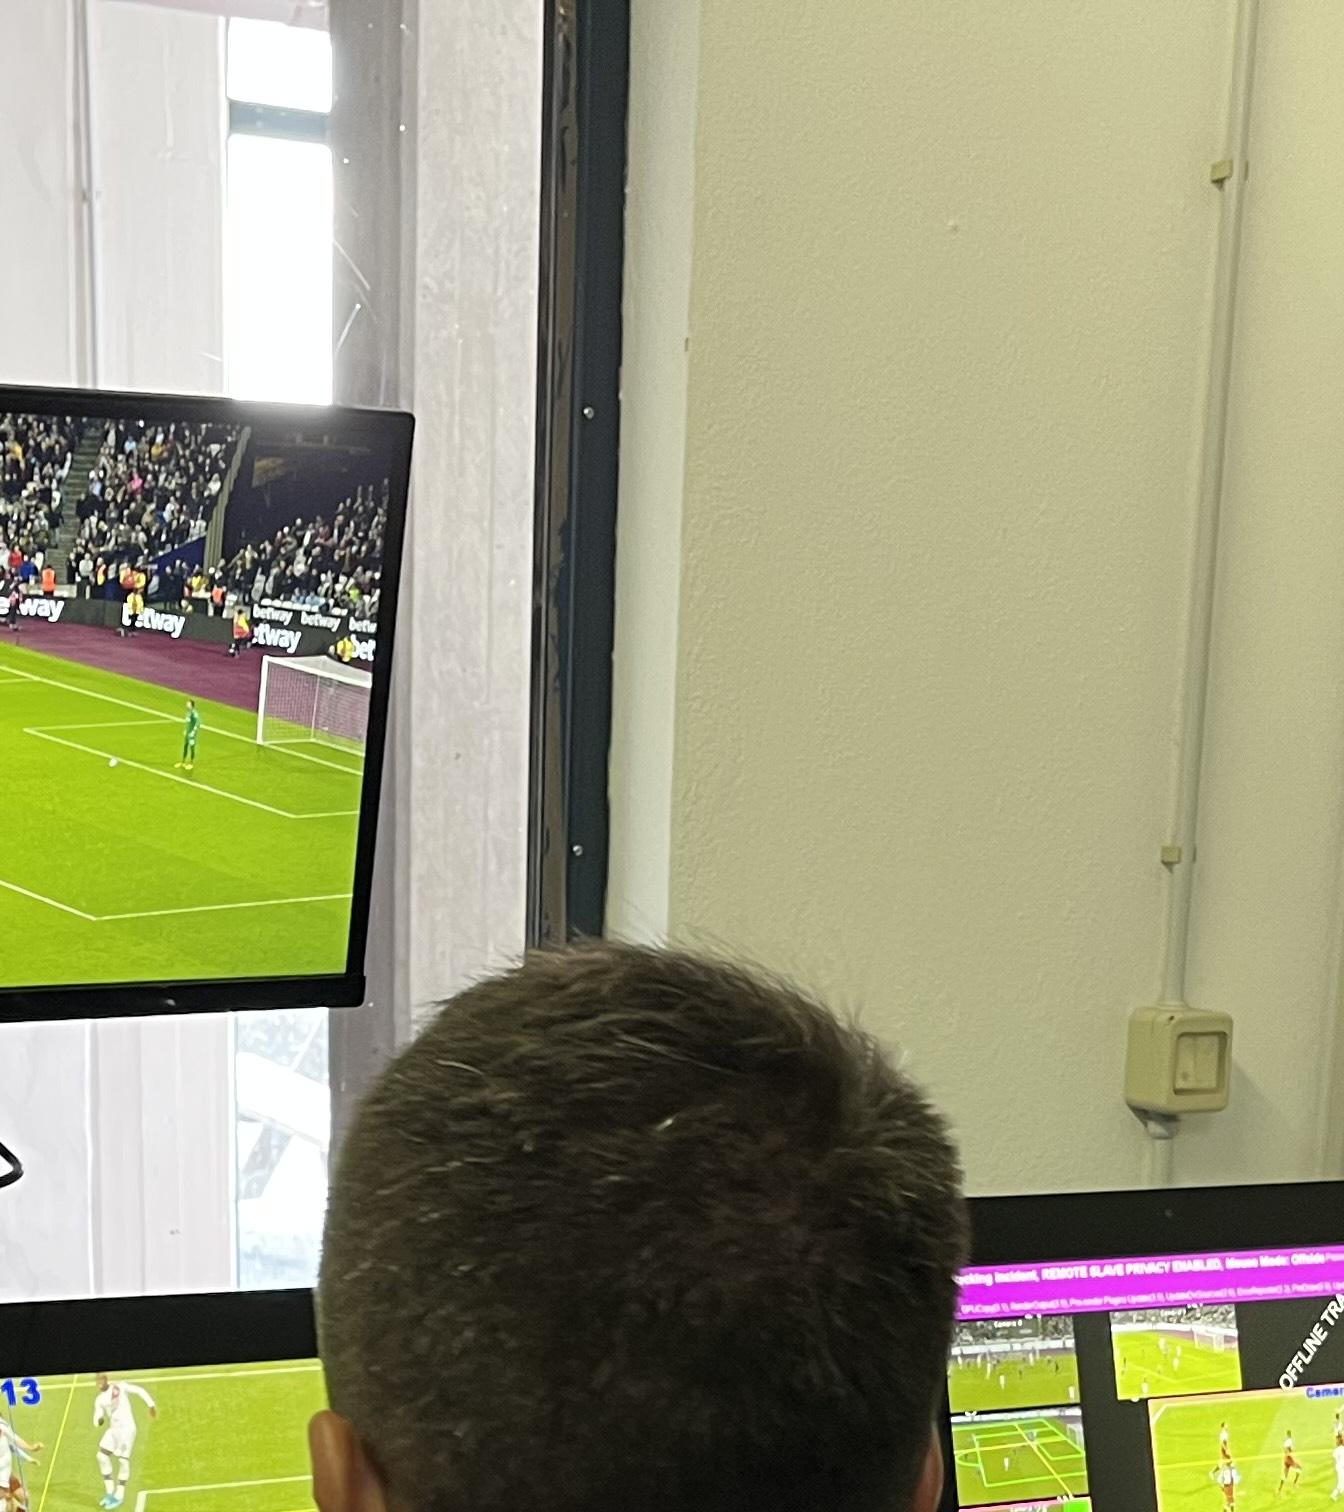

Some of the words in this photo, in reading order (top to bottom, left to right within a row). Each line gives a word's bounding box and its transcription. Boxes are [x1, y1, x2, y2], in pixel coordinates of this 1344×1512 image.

[253, 603, 293, 626] betway
[301, 611, 341, 632] betway
[1041, 1265, 1089, 1280] REMOTE
[1089, 1263, 1125, 1278] SLAVE
[1125, 1260, 1171, 1276] PRIVACY
[1278, 1322, 1329, 1392] OFFLINE
[0, 1377, 42, 1407] 13
